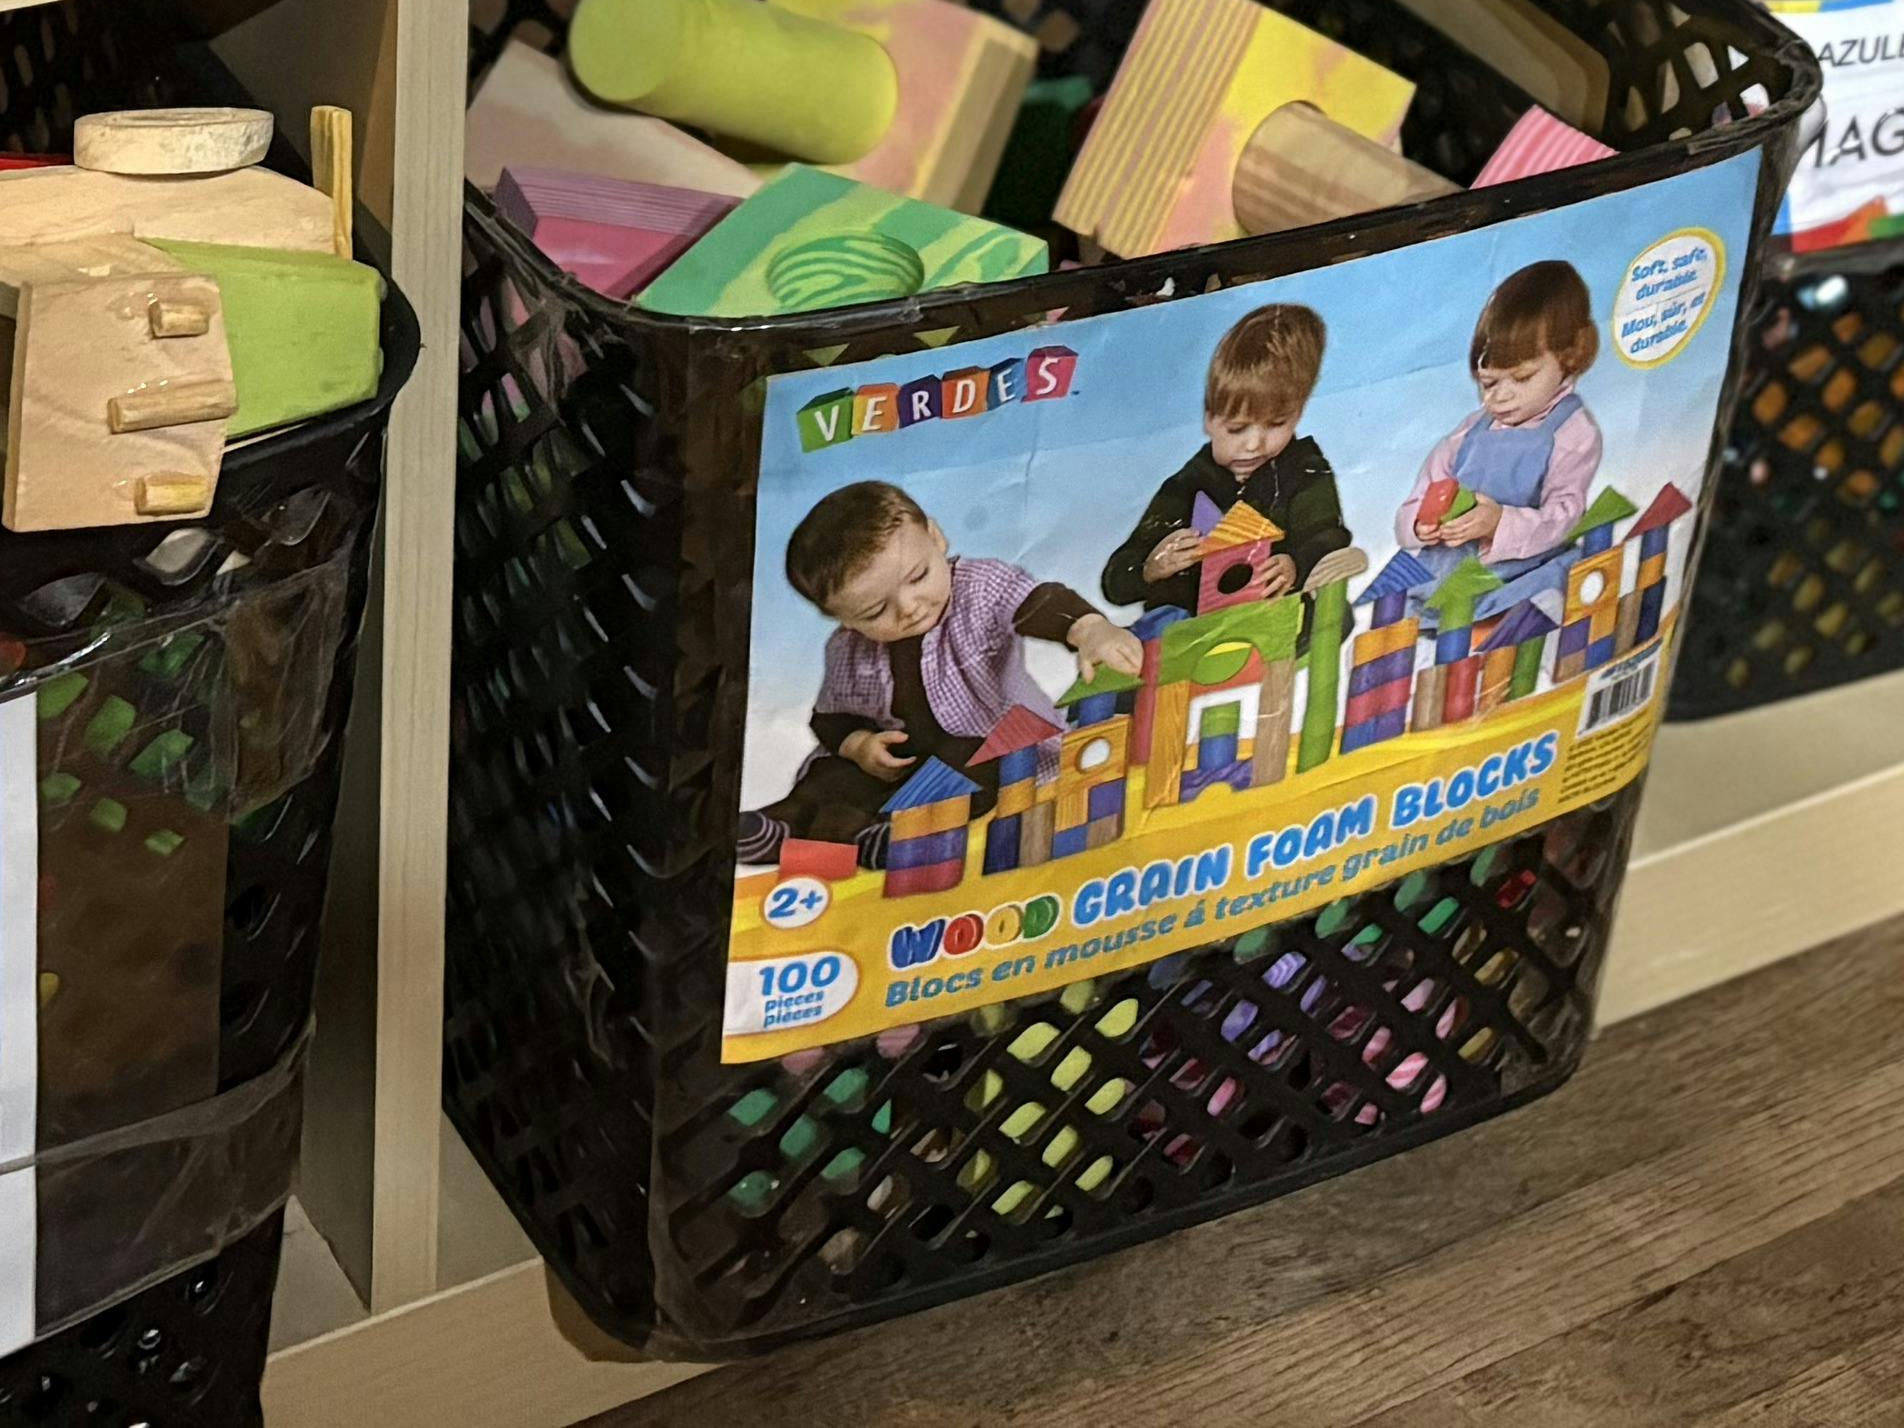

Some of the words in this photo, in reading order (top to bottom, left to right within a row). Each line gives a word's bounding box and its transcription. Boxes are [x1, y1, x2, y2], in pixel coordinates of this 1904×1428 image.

[813, 356, 1062, 442] VERDES
[890, 894, 1061, 970] WOOD
[1073, 844, 1232, 927] GRAIN
[1245, 794, 1377, 878] FOAM
[1389, 729, 1558, 828] BLOCKS
[768, 887, 823, 919] 2+
[885, 967, 984, 1008] Blocs
[992, 955, 1037, 982] en
[1044, 913, 1175, 970] mousse
[1215, 861, 1337, 921] texture
[1342, 832, 1429, 883] grain
[1436, 814, 1474, 846] de
[1480, 787, 1541, 829] bois
[759, 955, 841, 996] 100
